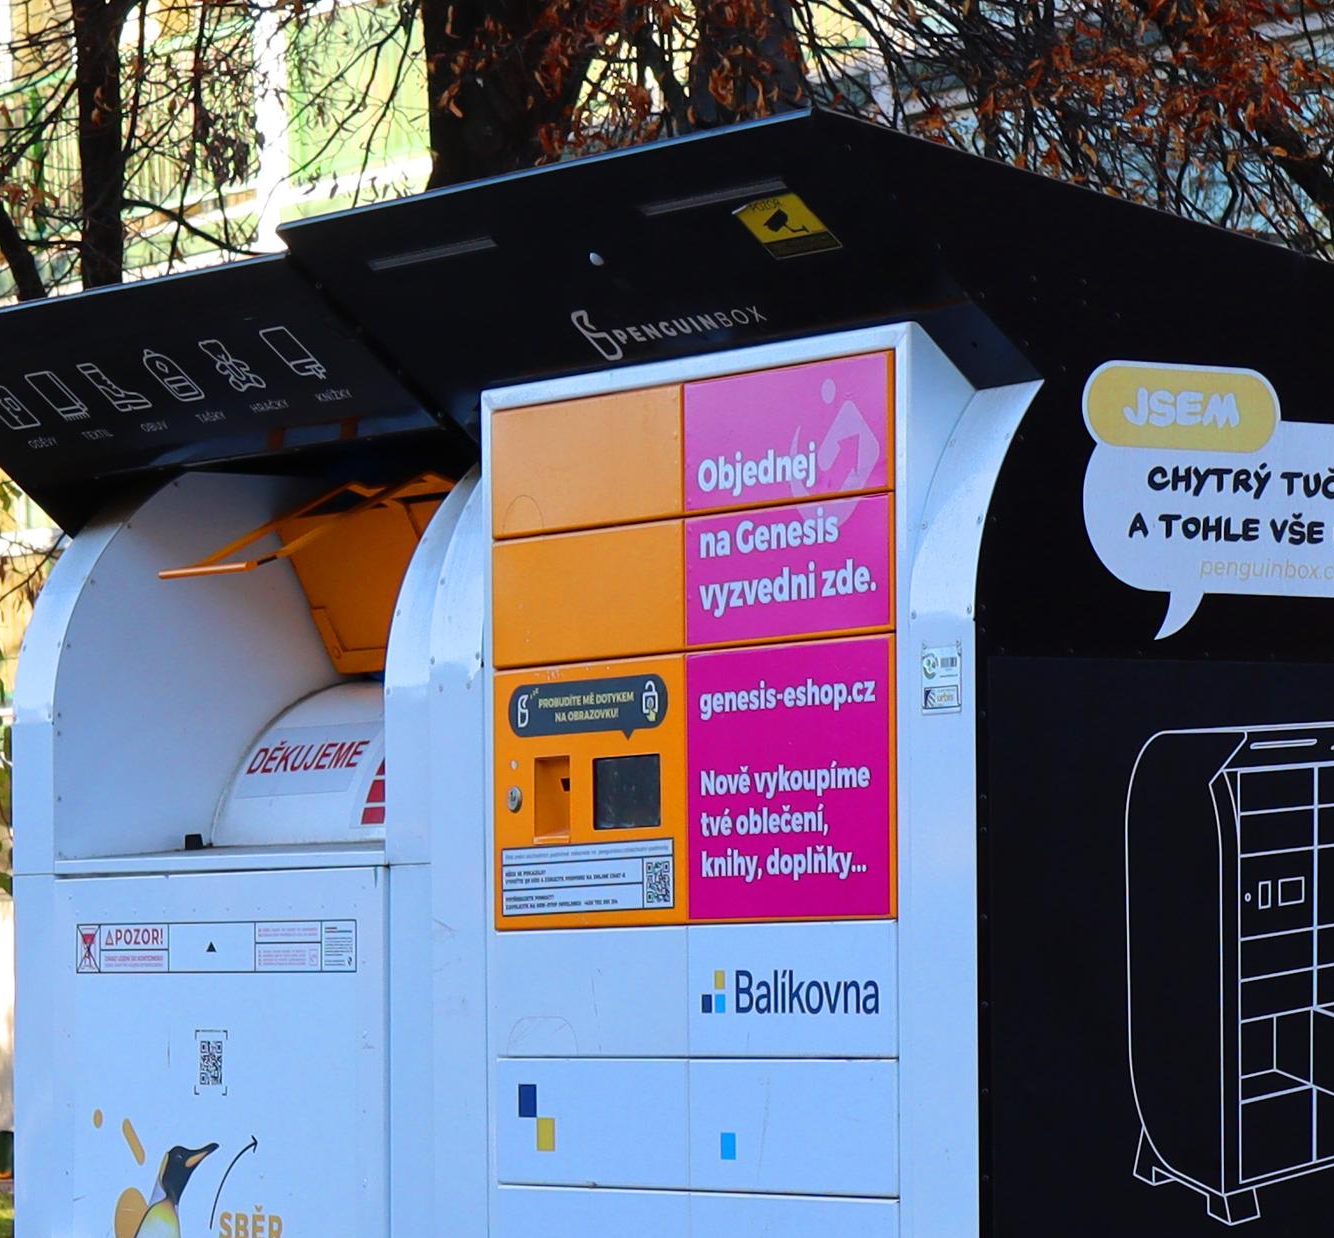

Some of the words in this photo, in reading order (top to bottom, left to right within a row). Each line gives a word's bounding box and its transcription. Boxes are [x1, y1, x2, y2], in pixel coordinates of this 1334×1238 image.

[612, 305, 767, 344] PENGUINBOX
[1122, 387, 1241, 429] JSEM
[697, 441, 816, 496] Objednej
[1147, 463, 1271, 499] CHYTRÝ
[699, 529, 731, 559] na
[735, 507, 839, 554] Genesis
[1128, 512, 1149, 539] A
[1158, 513, 1261, 543] TOHLE
[1270, 512, 1325, 546] VŠE
[699, 561, 815, 617] vyzvedni
[821, 559, 877, 597] zde.
[554, 711, 566, 722] NA
[567, 707, 619, 721] OBRAZOVKU!
[596, 691, 635, 704] DOTYKEM
[699, 678, 876, 720] genesis-eshop.cz
[246, 740, 370, 775] DĚKUJEME
[700, 766, 751, 796] Nově
[754, 761, 871, 799] vykoupíme
[700, 808, 732, 837] tvé
[735, 804, 829, 837] oblečení,
[700, 848, 764, 883] knihy,
[766, 845, 868, 879] doplňky...
[115, 928, 163, 945] POZOR!
[734, 969, 880, 1015] Balíkovna
